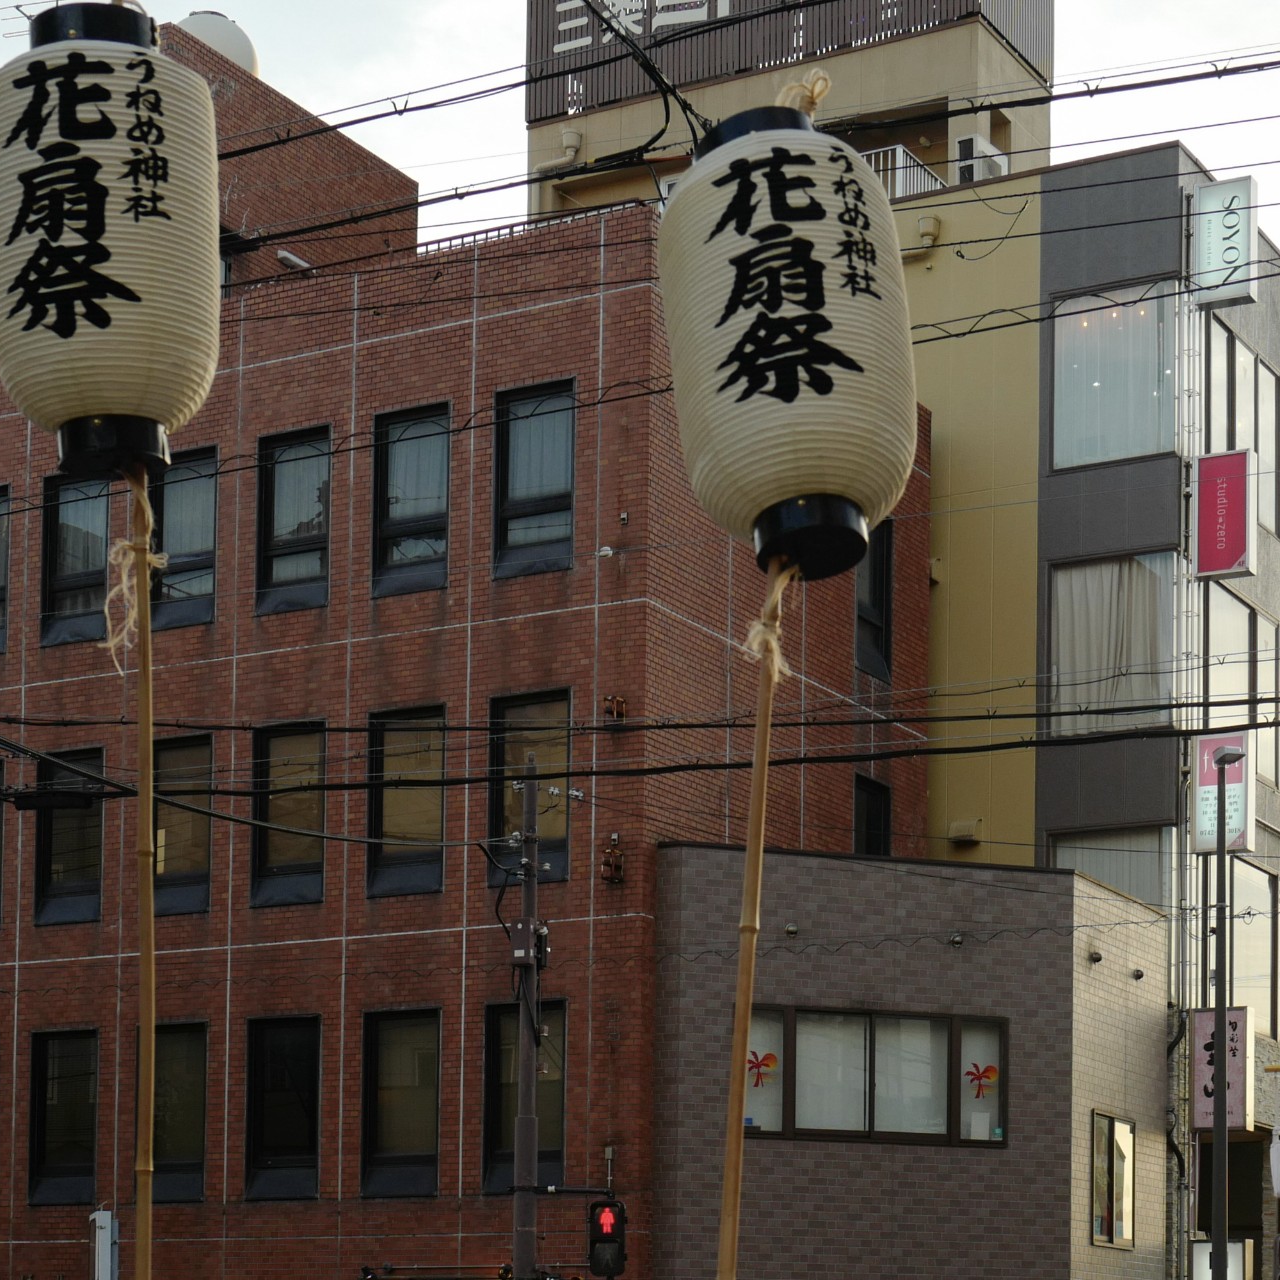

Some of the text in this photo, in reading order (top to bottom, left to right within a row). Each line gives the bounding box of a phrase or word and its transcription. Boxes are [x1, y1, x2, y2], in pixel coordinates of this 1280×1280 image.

[1, 51, 142, 340] 花扇祭
[117, 51, 172, 223] うねめ神社
[828, 145, 883, 301] うねめ神社
[703, 146, 865, 404] 花扇祭
[1222, 195, 1241, 286] SOYON
